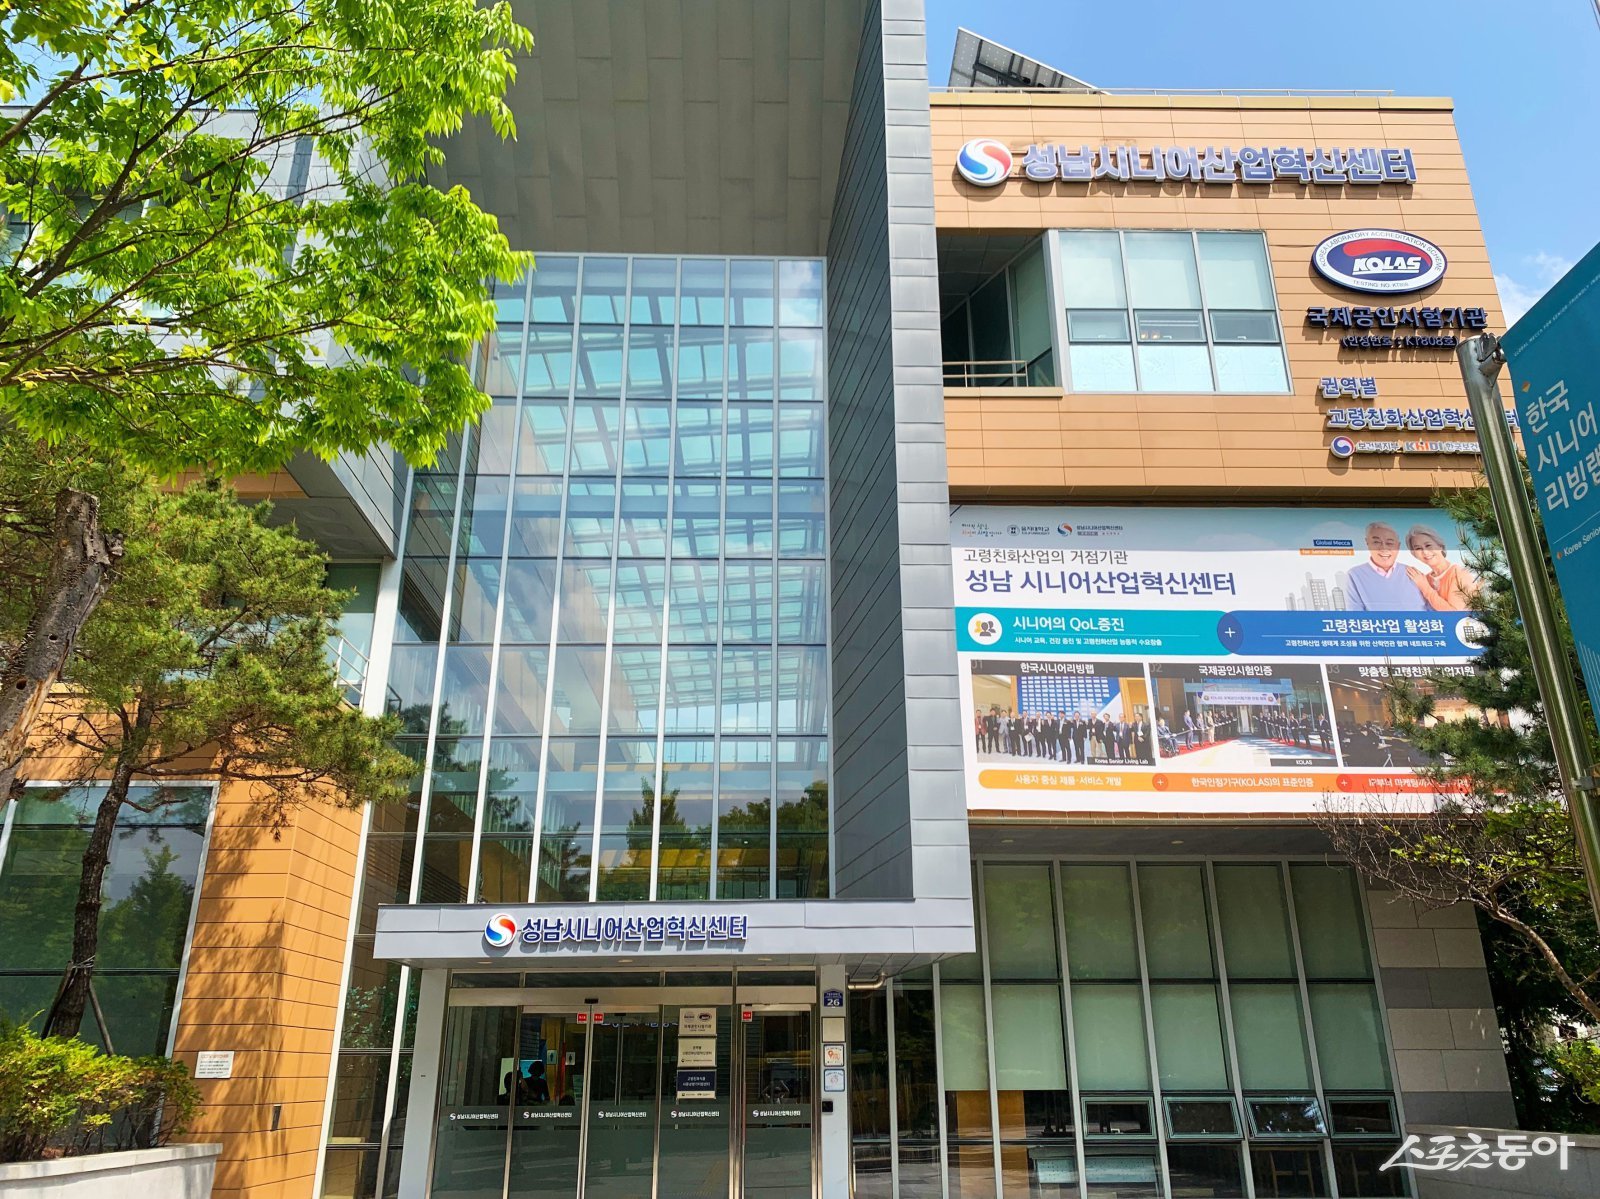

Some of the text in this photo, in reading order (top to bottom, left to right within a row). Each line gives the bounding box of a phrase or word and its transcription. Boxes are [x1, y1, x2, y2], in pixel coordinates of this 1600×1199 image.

[1023, 144, 1418, 184] 성남시니어산업혁신센터
[1327, 231, 1369, 248] LABORATORY
[1370, 231, 1427, 248] ACCREDITATION
[1353, 256, 1422, 273] KOLAS
[1308, 306, 1488, 329] 국제공인시험기관
[1320, 377, 1378, 397] 권역별
[1525, 379, 1570, 434] 한국
[1537, 401, 1598, 472] 시니어
[1357, 441, 1400, 451] 보건복지부
[964, 548, 1129, 566] 고령친화산업의 거점기관
[965, 569, 1237, 595] 성남 시니어산업혁신센터
[1013, 616, 1125, 632] 시니어의 QoL증진
[1322, 619, 1444, 634] 고령친화산업 활성화
[1020, 662, 1095, 675] 한국시니어리빙랩
[1198, 665, 1273, 676] 국제공인시험인증
[1359, 666, 1389, 677] 맞춤형
[1014, 775, 1039, 784] 사용자
[1105, 776, 1122, 786] 개발
[1282, 777, 1314, 788] 표준인증
[522, 914, 749, 943] 성남시니어산업혁신센터
[827, 998, 840, 1006] 26
